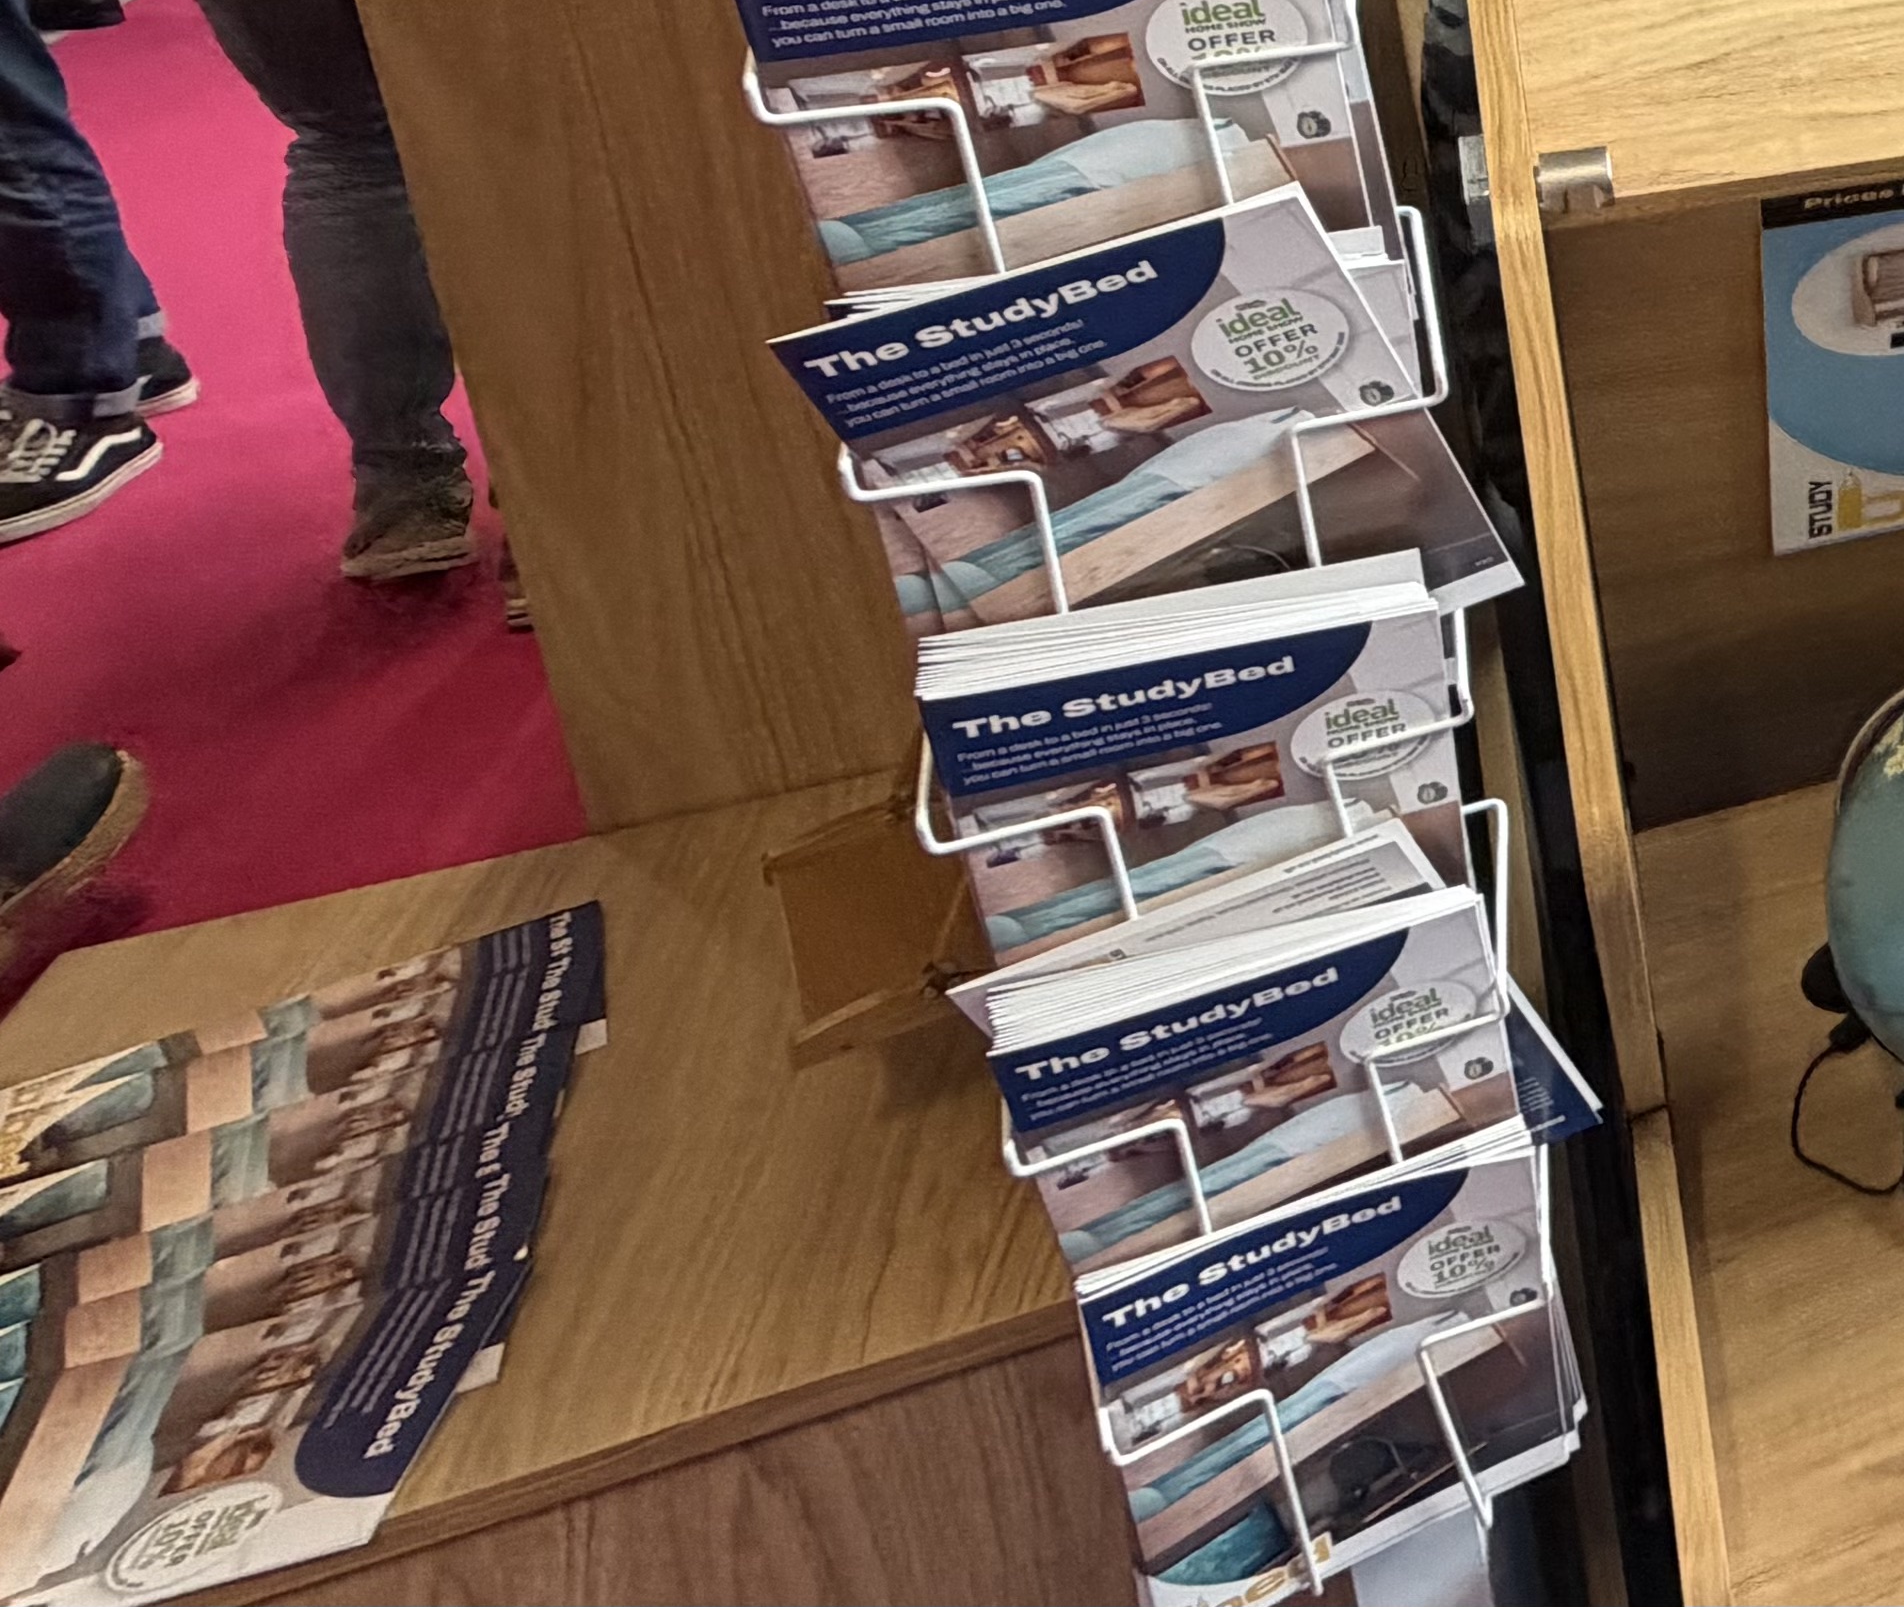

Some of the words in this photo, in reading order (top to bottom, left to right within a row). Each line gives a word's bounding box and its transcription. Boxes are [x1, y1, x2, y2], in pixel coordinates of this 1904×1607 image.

[1187, 29, 1276, 51] OFFER
[803, 338, 909, 380] The
[914, 260, 1158, 348] StudyBed
[1216, 298, 1301, 337] ideal
[1235, 323, 1318, 358] OFFER
[1244, 339, 1318, 374] 10%
[1808, 480, 1833, 539] STUDY
[952, 707, 1052, 740] The
[1062, 656, 1296, 718] StudyBed
[1324, 698, 1399, 729] ideal
[1328, 723, 1406, 748] OFFER
[1015, 1043, 1110, 1081] The
[1118, 967, 1339, 1049] StudyBed
[1369, 988, 1442, 1025] ideal
[1374, 1008, 1448, 1040] OFFER
[1101, 1283, 1191, 1330] The
[1197, 1196, 1402, 1286] StudyBed
[446, 1269, 496, 1322] The
[362, 1322, 465, 1459] StudyBed
